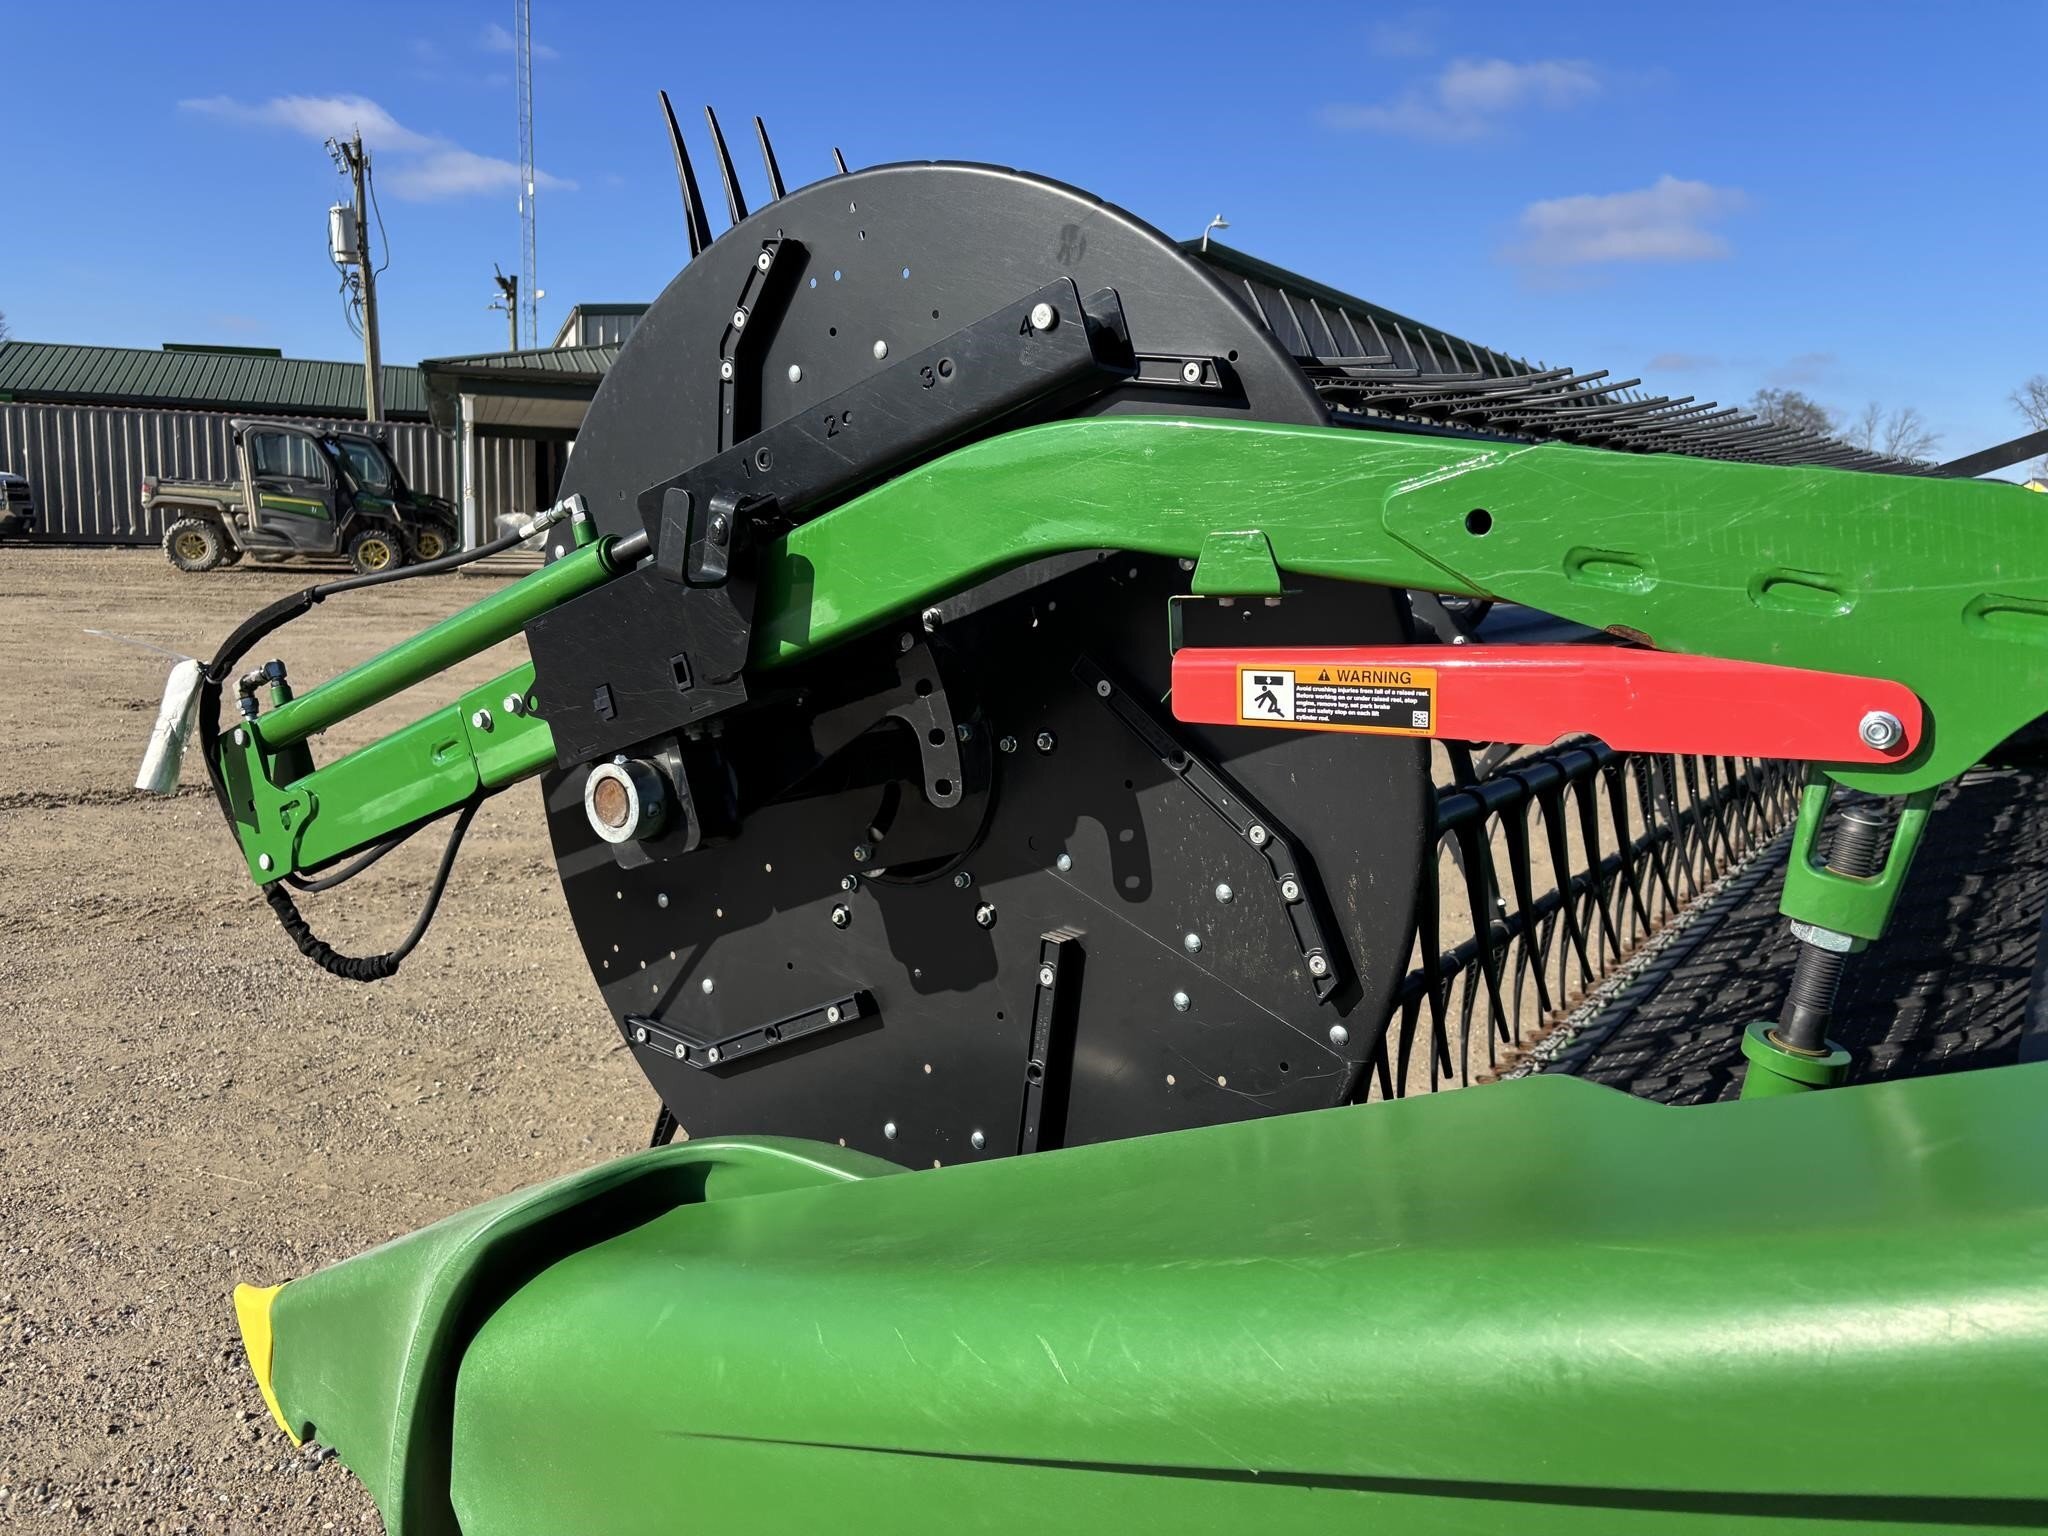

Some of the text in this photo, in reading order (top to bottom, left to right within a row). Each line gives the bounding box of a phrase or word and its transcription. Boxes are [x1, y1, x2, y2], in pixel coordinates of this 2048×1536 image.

[1019, 314, 1035, 338] 4
[920, 366, 935, 390] 3
[824, 414, 840, 439] 2
[742, 458, 751, 479] 1
[1336, 669, 1412, 685] WARNING
[1312, 686, 1337, 694] crushing
[1337, 686, 1359, 694] injuries
[1315, 693, 1337, 701] working
[1316, 708, 1334, 716] safety
[1338, 701, 1350, 709] key,
